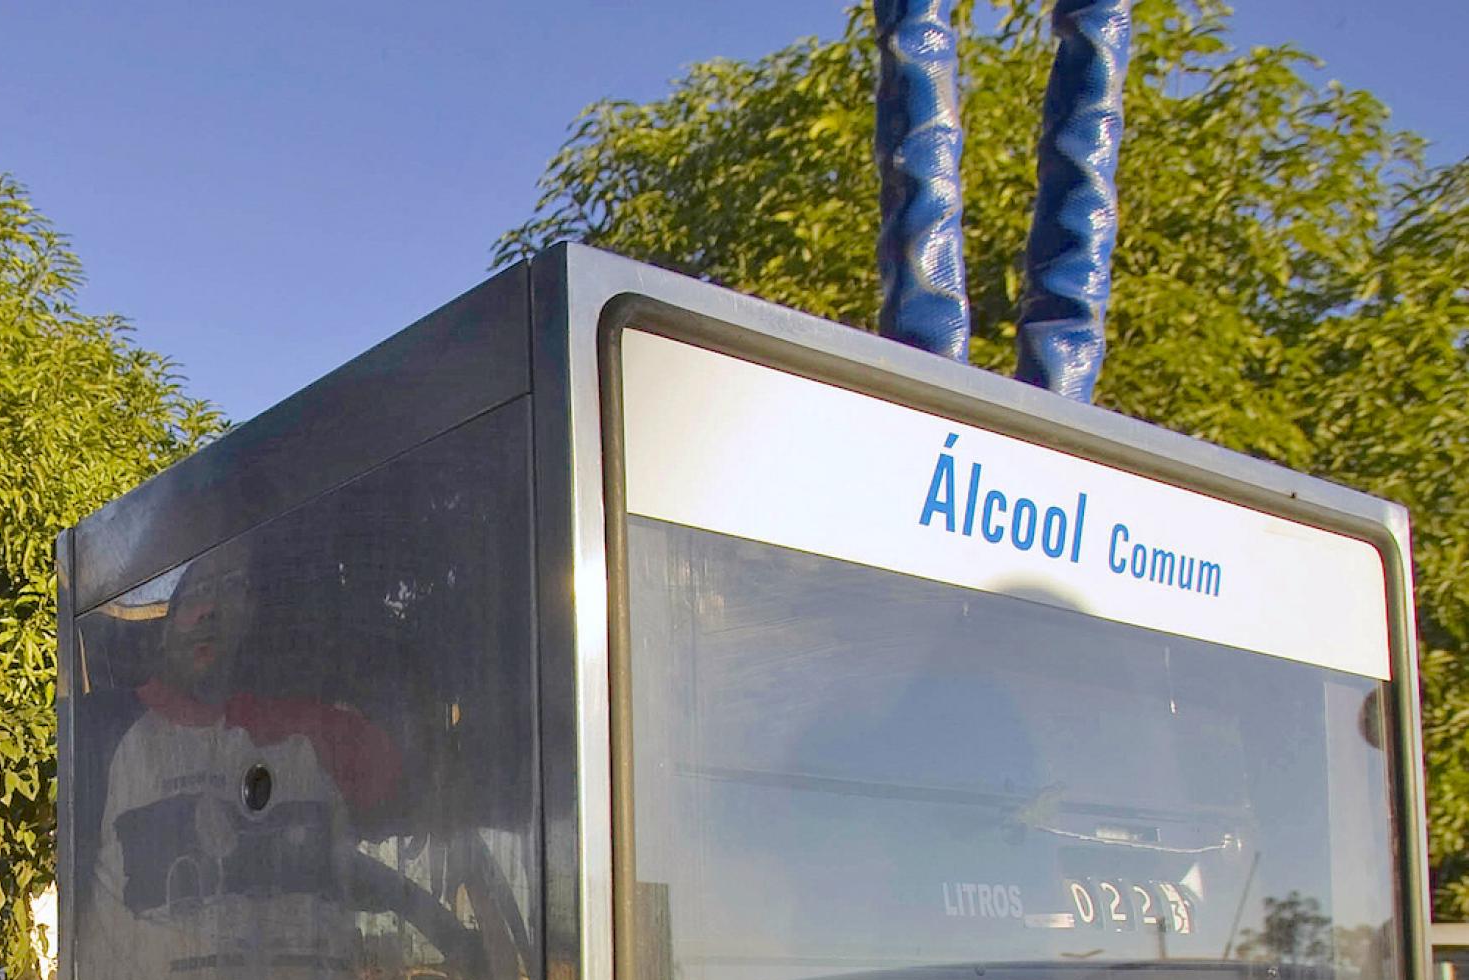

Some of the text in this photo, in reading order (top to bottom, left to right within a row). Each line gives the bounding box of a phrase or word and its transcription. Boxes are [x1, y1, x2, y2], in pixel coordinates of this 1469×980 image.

[919, 432, 1221, 597] Álcool Comum
[942, 882, 1023, 918] LITROS
